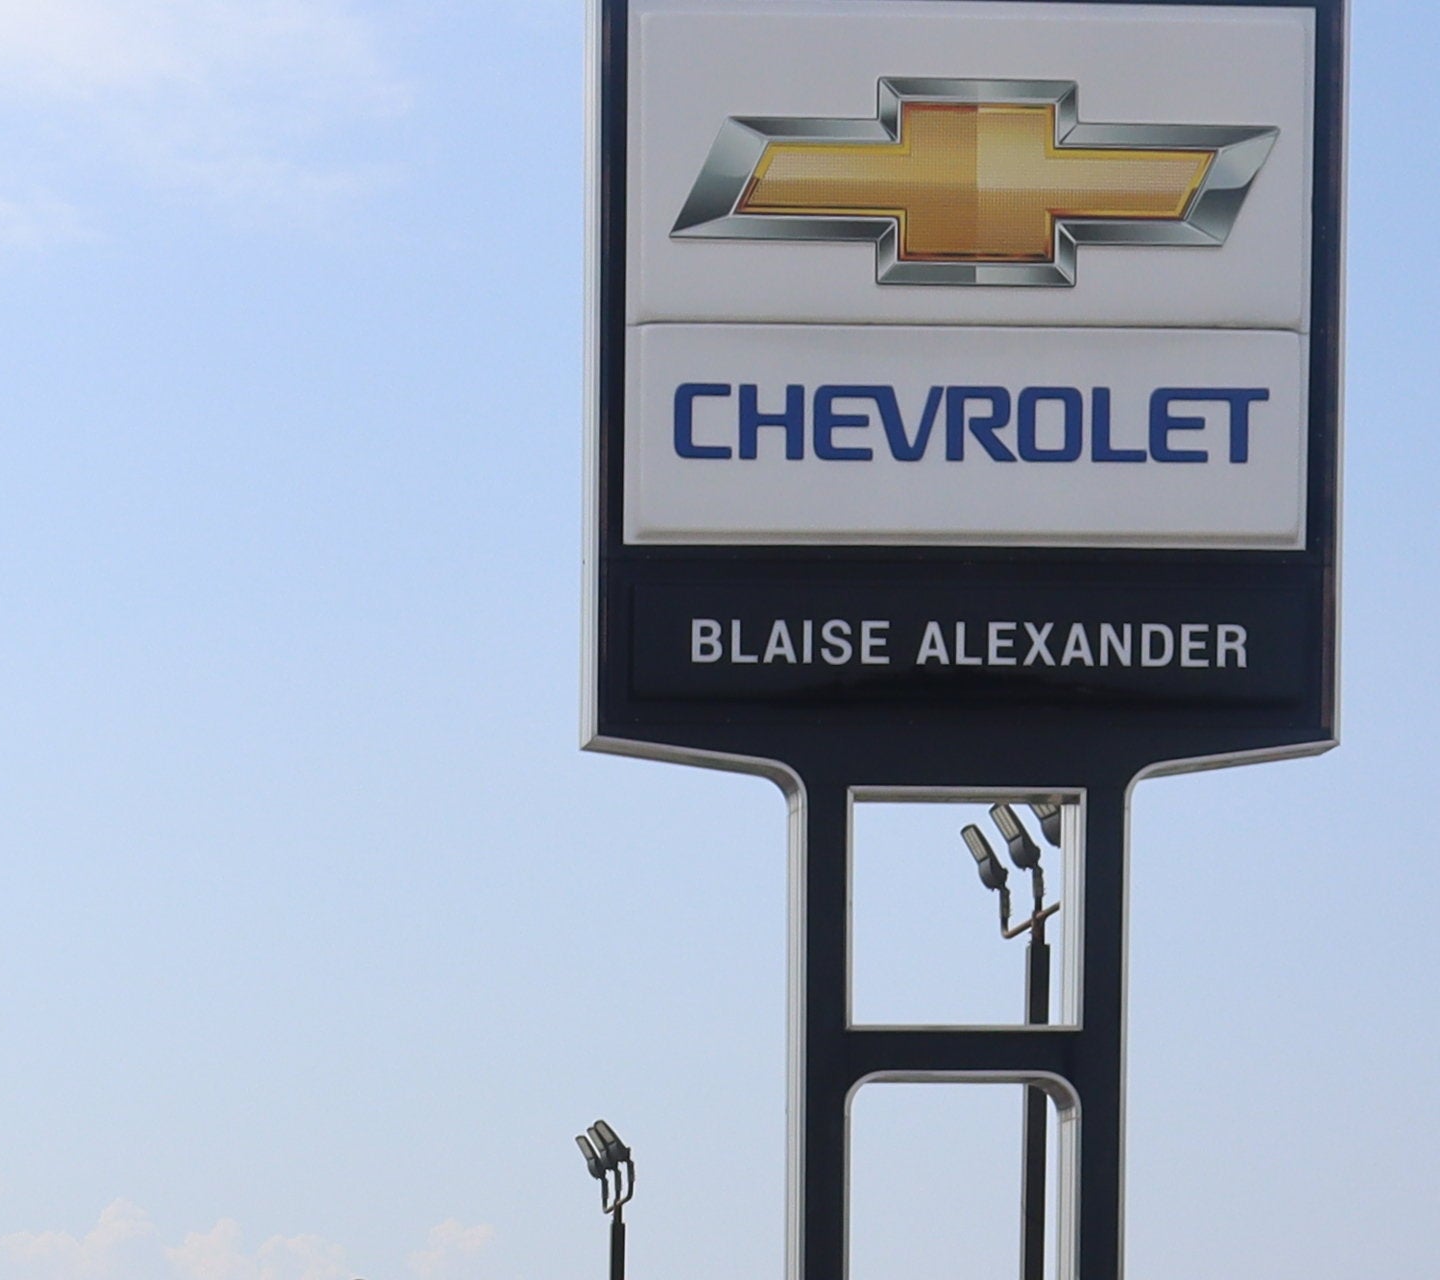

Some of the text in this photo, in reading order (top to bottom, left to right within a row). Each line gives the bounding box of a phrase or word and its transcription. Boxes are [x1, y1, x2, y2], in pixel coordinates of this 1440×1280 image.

[673, 383, 1270, 464] CHEVROLET
[691, 619, 1249, 668] BLAISE ALEXANDER
